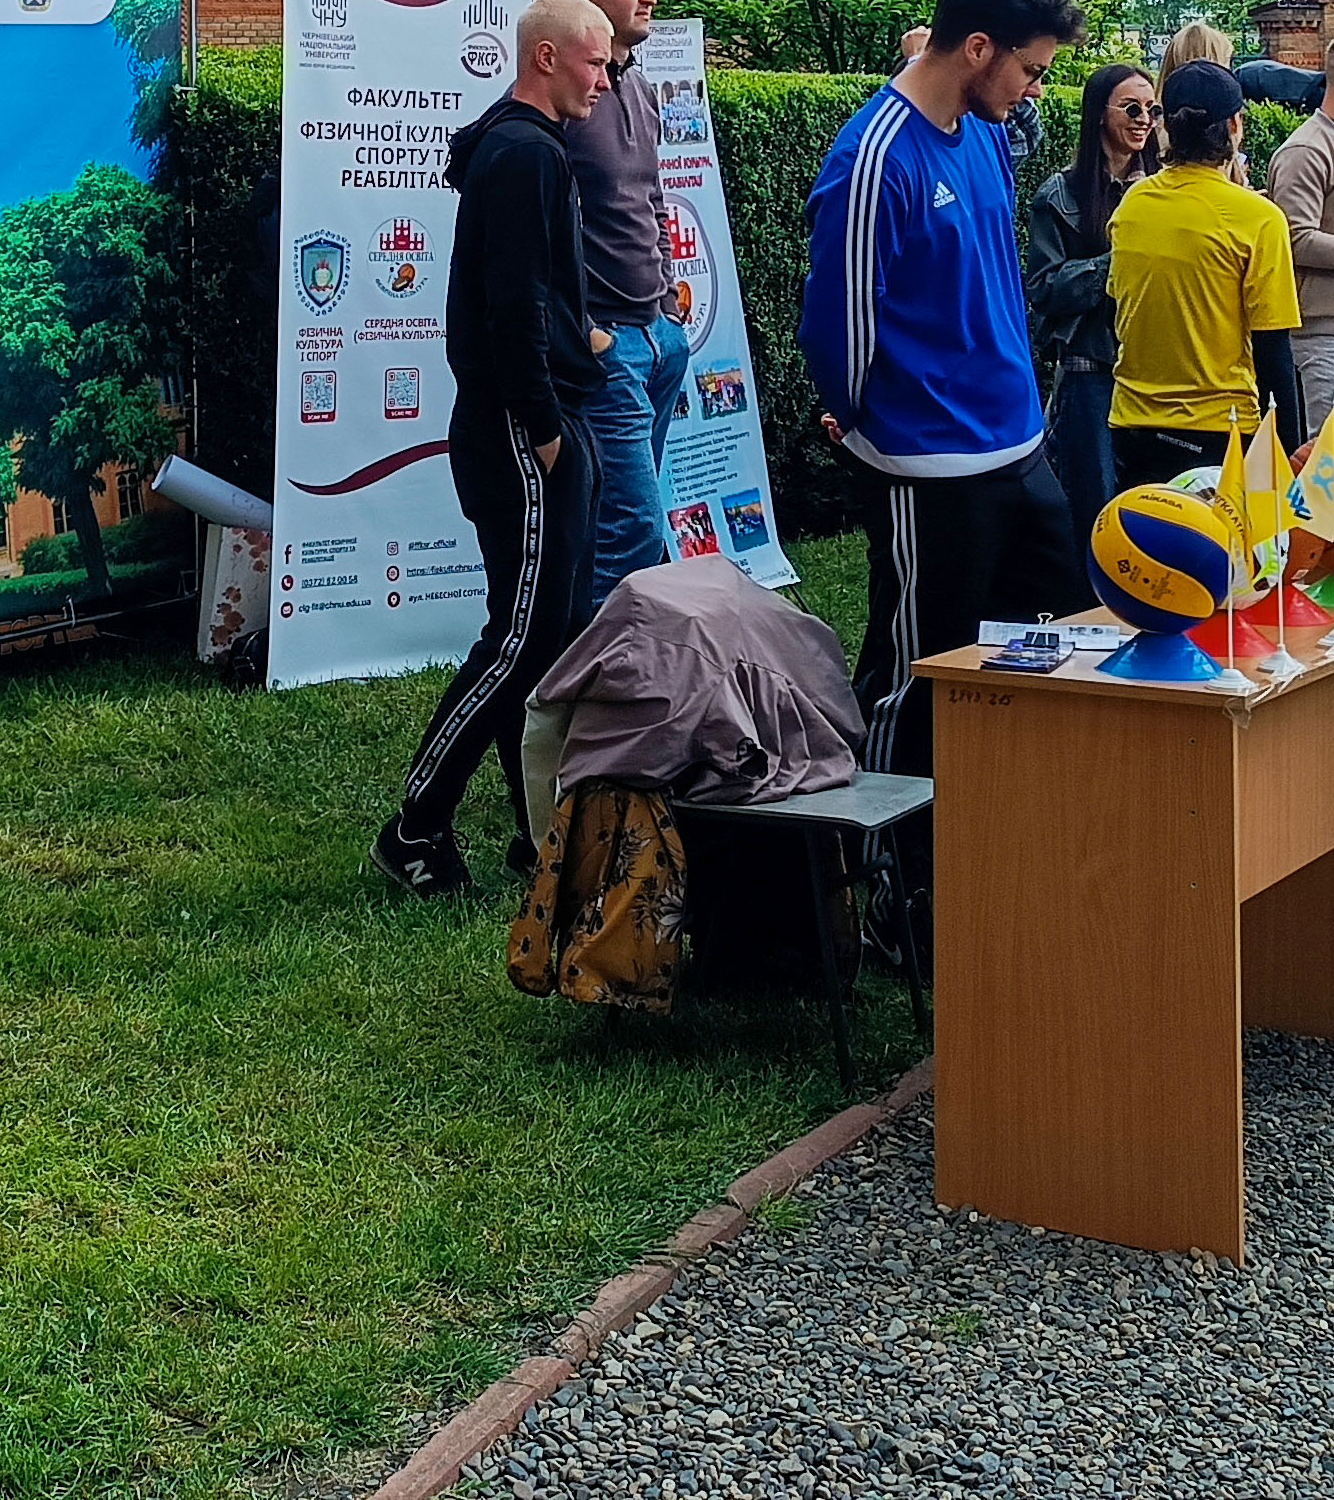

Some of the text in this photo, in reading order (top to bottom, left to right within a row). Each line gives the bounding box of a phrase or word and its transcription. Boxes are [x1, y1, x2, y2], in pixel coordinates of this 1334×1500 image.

[311, 8, 348, 28] ЧНУ
[302, 31, 355, 42] ЧЕРНІВЕЦЬКИЙ
[299, 40, 357, 51] НАЦІОНАЛЬНИЙ
[304, 50, 351, 61] УНІВЕРСИТЕТ
[467, 51, 499, 67] ФКСР
[347, 87, 463, 111] ФАКУЛЬТЕТ
[300, 119, 464, 144] ФІЗИЧНОЇ КУЛЬ
[355, 146, 430, 167] СПОРТУ
[368, 251, 434, 262] СЕРЕДНЯ ОСВІТА
[364, 317, 438, 331] СЕРЕДНЯ ОСВІТА
[298, 327, 344, 338] ФІЗИЧНА
[353, 330, 400, 344] (ФІЗИЧНА
[295, 339, 344, 350] КУЛЬТУРА
[300, 351, 338, 362] І СПОРТ
